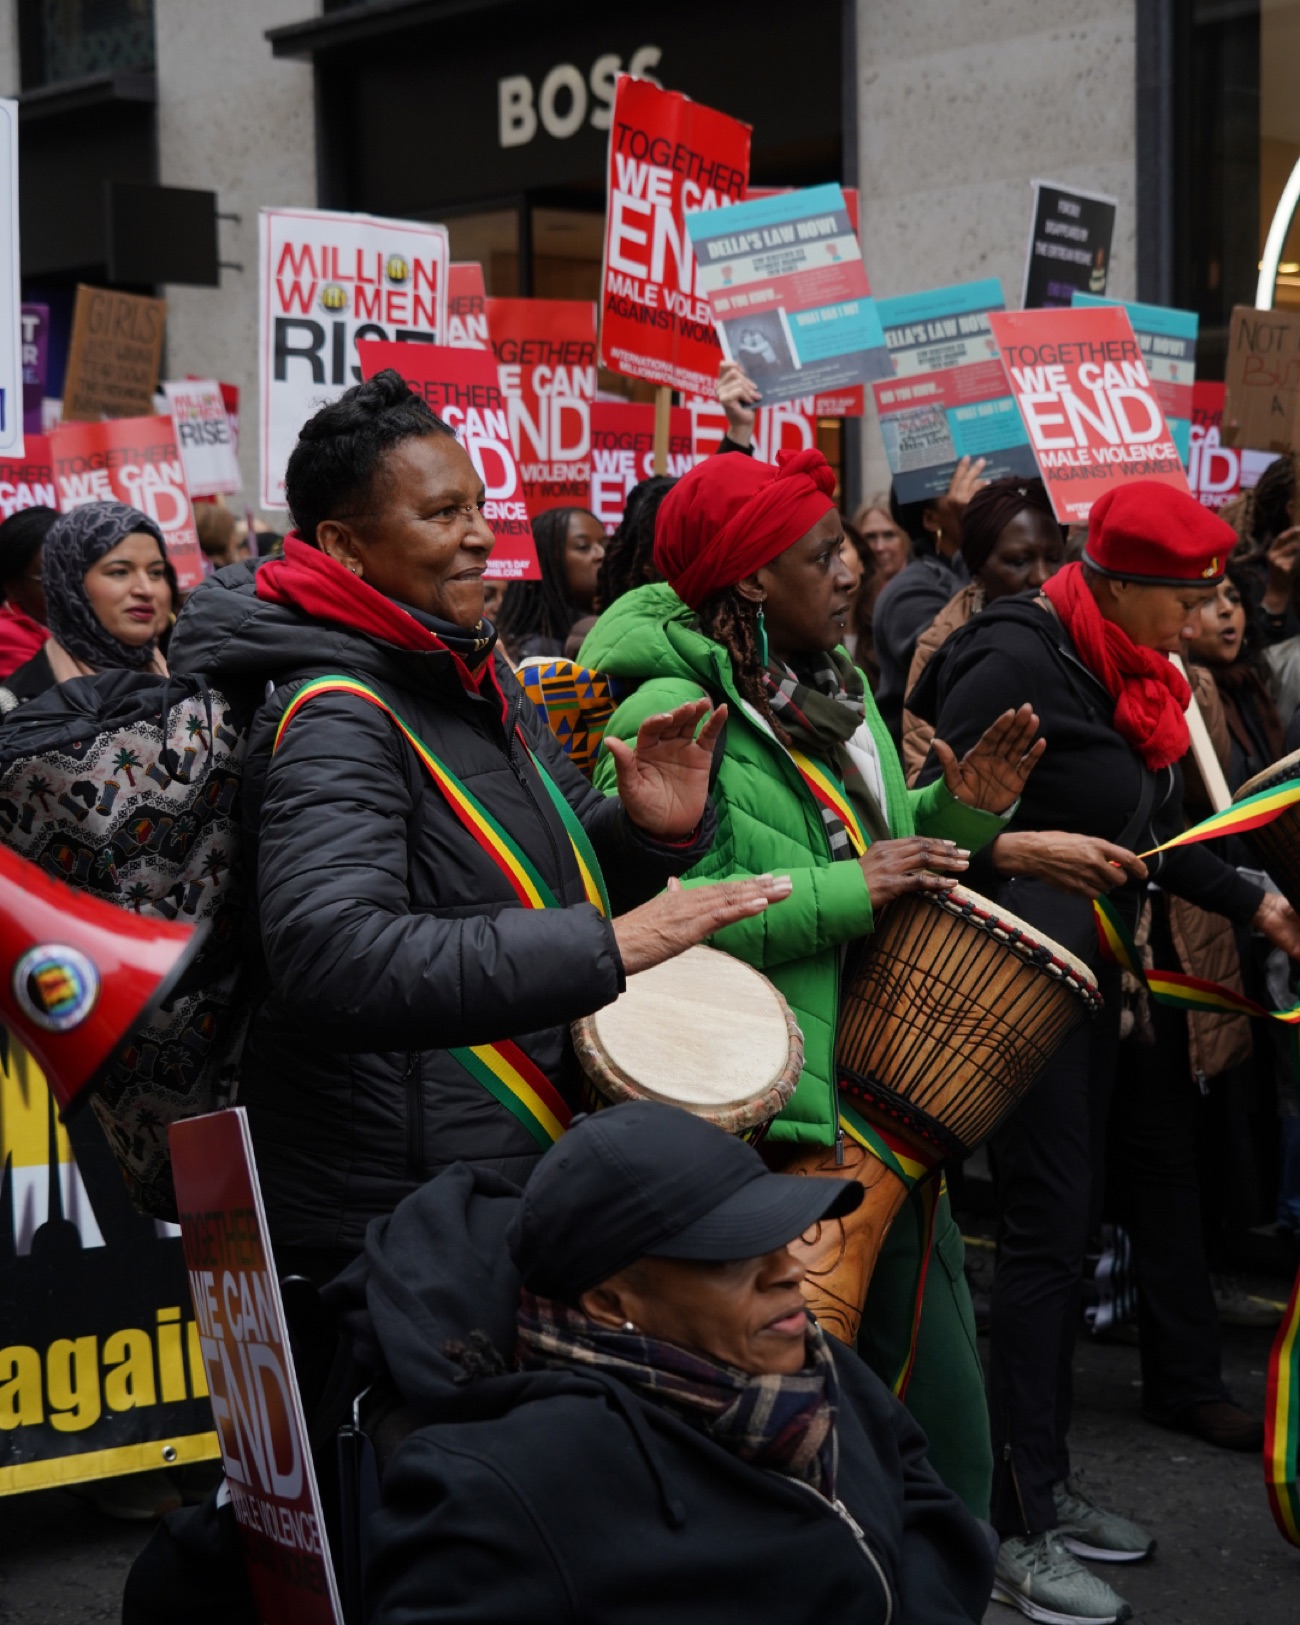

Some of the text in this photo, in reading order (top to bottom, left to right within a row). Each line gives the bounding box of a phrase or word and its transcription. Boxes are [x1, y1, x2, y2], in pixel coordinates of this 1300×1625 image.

[616, 122, 746, 197] TOGETHER
[615, 152, 674, 207] WE
[707, 216, 838, 260] DELLA'S LAW NOW!
[608, 271, 658, 307] MALE
[88, 293, 160, 344] GIRLS
[606, 296, 676, 332] AGAINST
[885, 325, 927, 349] ELLA'S
[927, 317, 958, 341] LAW
[1238, 318, 1290, 353] NOT
[274, 316, 435, 386] RI
[610, 347, 674, 374] INTERNATIONA
[1002, 340, 1139, 366] TOGETHER
[407, 380, 501, 408] GETHER
[498, 365, 595, 399] E CAN
[1011, 365, 1071, 393] WE
[1078, 361, 1149, 391] CAN
[1019, 388, 1163, 449] END
[1270, 395, 1285, 417] A
[179, 420, 230, 448] RISE
[508, 399, 591, 462] ND
[592, 431, 693, 450] TOGETER
[1189, 425, 1221, 449] CA
[57, 445, 179, 474] TOGETHER
[592, 450, 636, 475] WE
[1039, 442, 1177, 467] MALE VIOLENCE
[1048, 458, 1181, 481] AGAINST WOMEN
[0, 482, 56, 509] CAN
[59, 462, 184, 499] WE CAN
[181, 1207, 265, 1267] TOGETHER
[189, 1269, 281, 1344] WE CAN
[199, 1334, 304, 1501] END
[229, 1486, 323, 1556] MALE VIOLENCE
